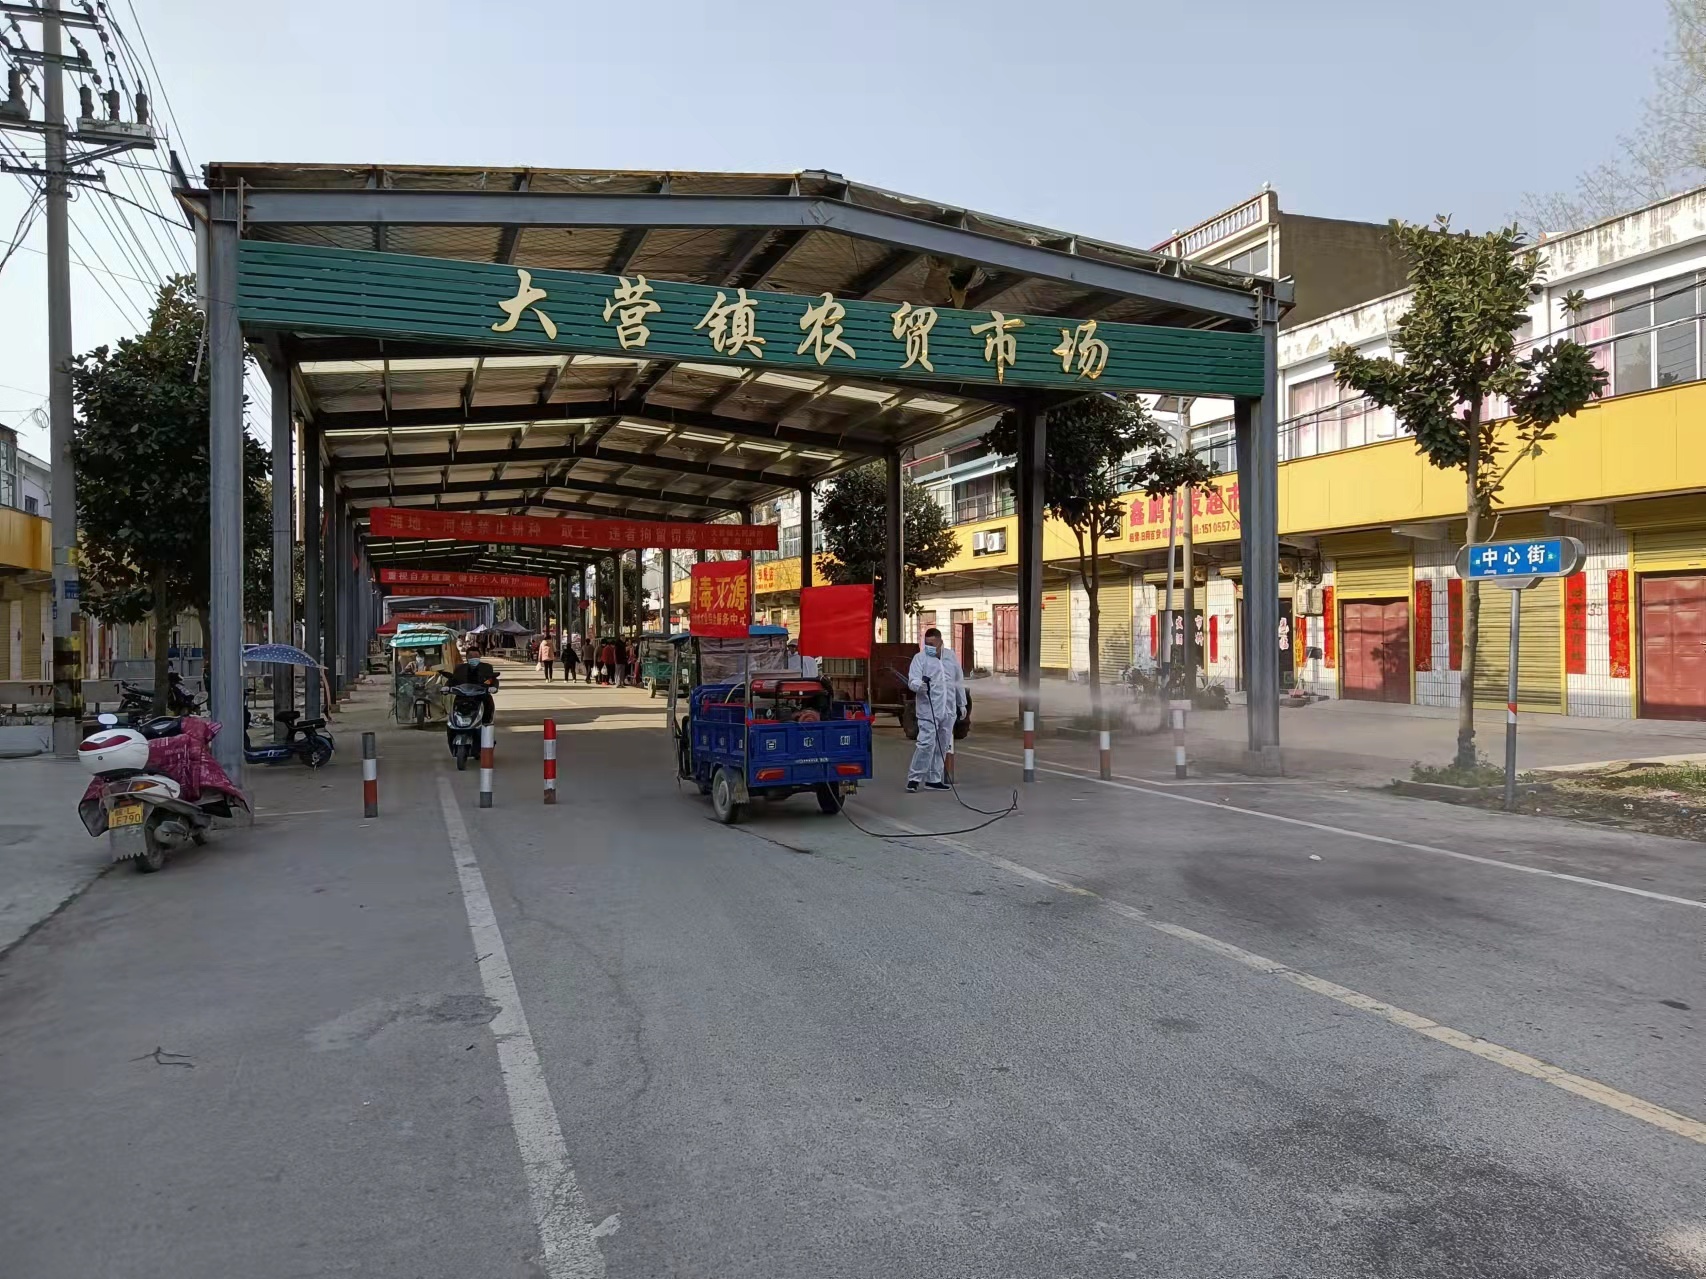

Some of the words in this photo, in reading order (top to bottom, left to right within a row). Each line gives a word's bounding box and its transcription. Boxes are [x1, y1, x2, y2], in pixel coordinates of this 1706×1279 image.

[491, 268, 1110, 384] 大营镇农贸市场
[1482, 545, 1545, 567] 中心街
